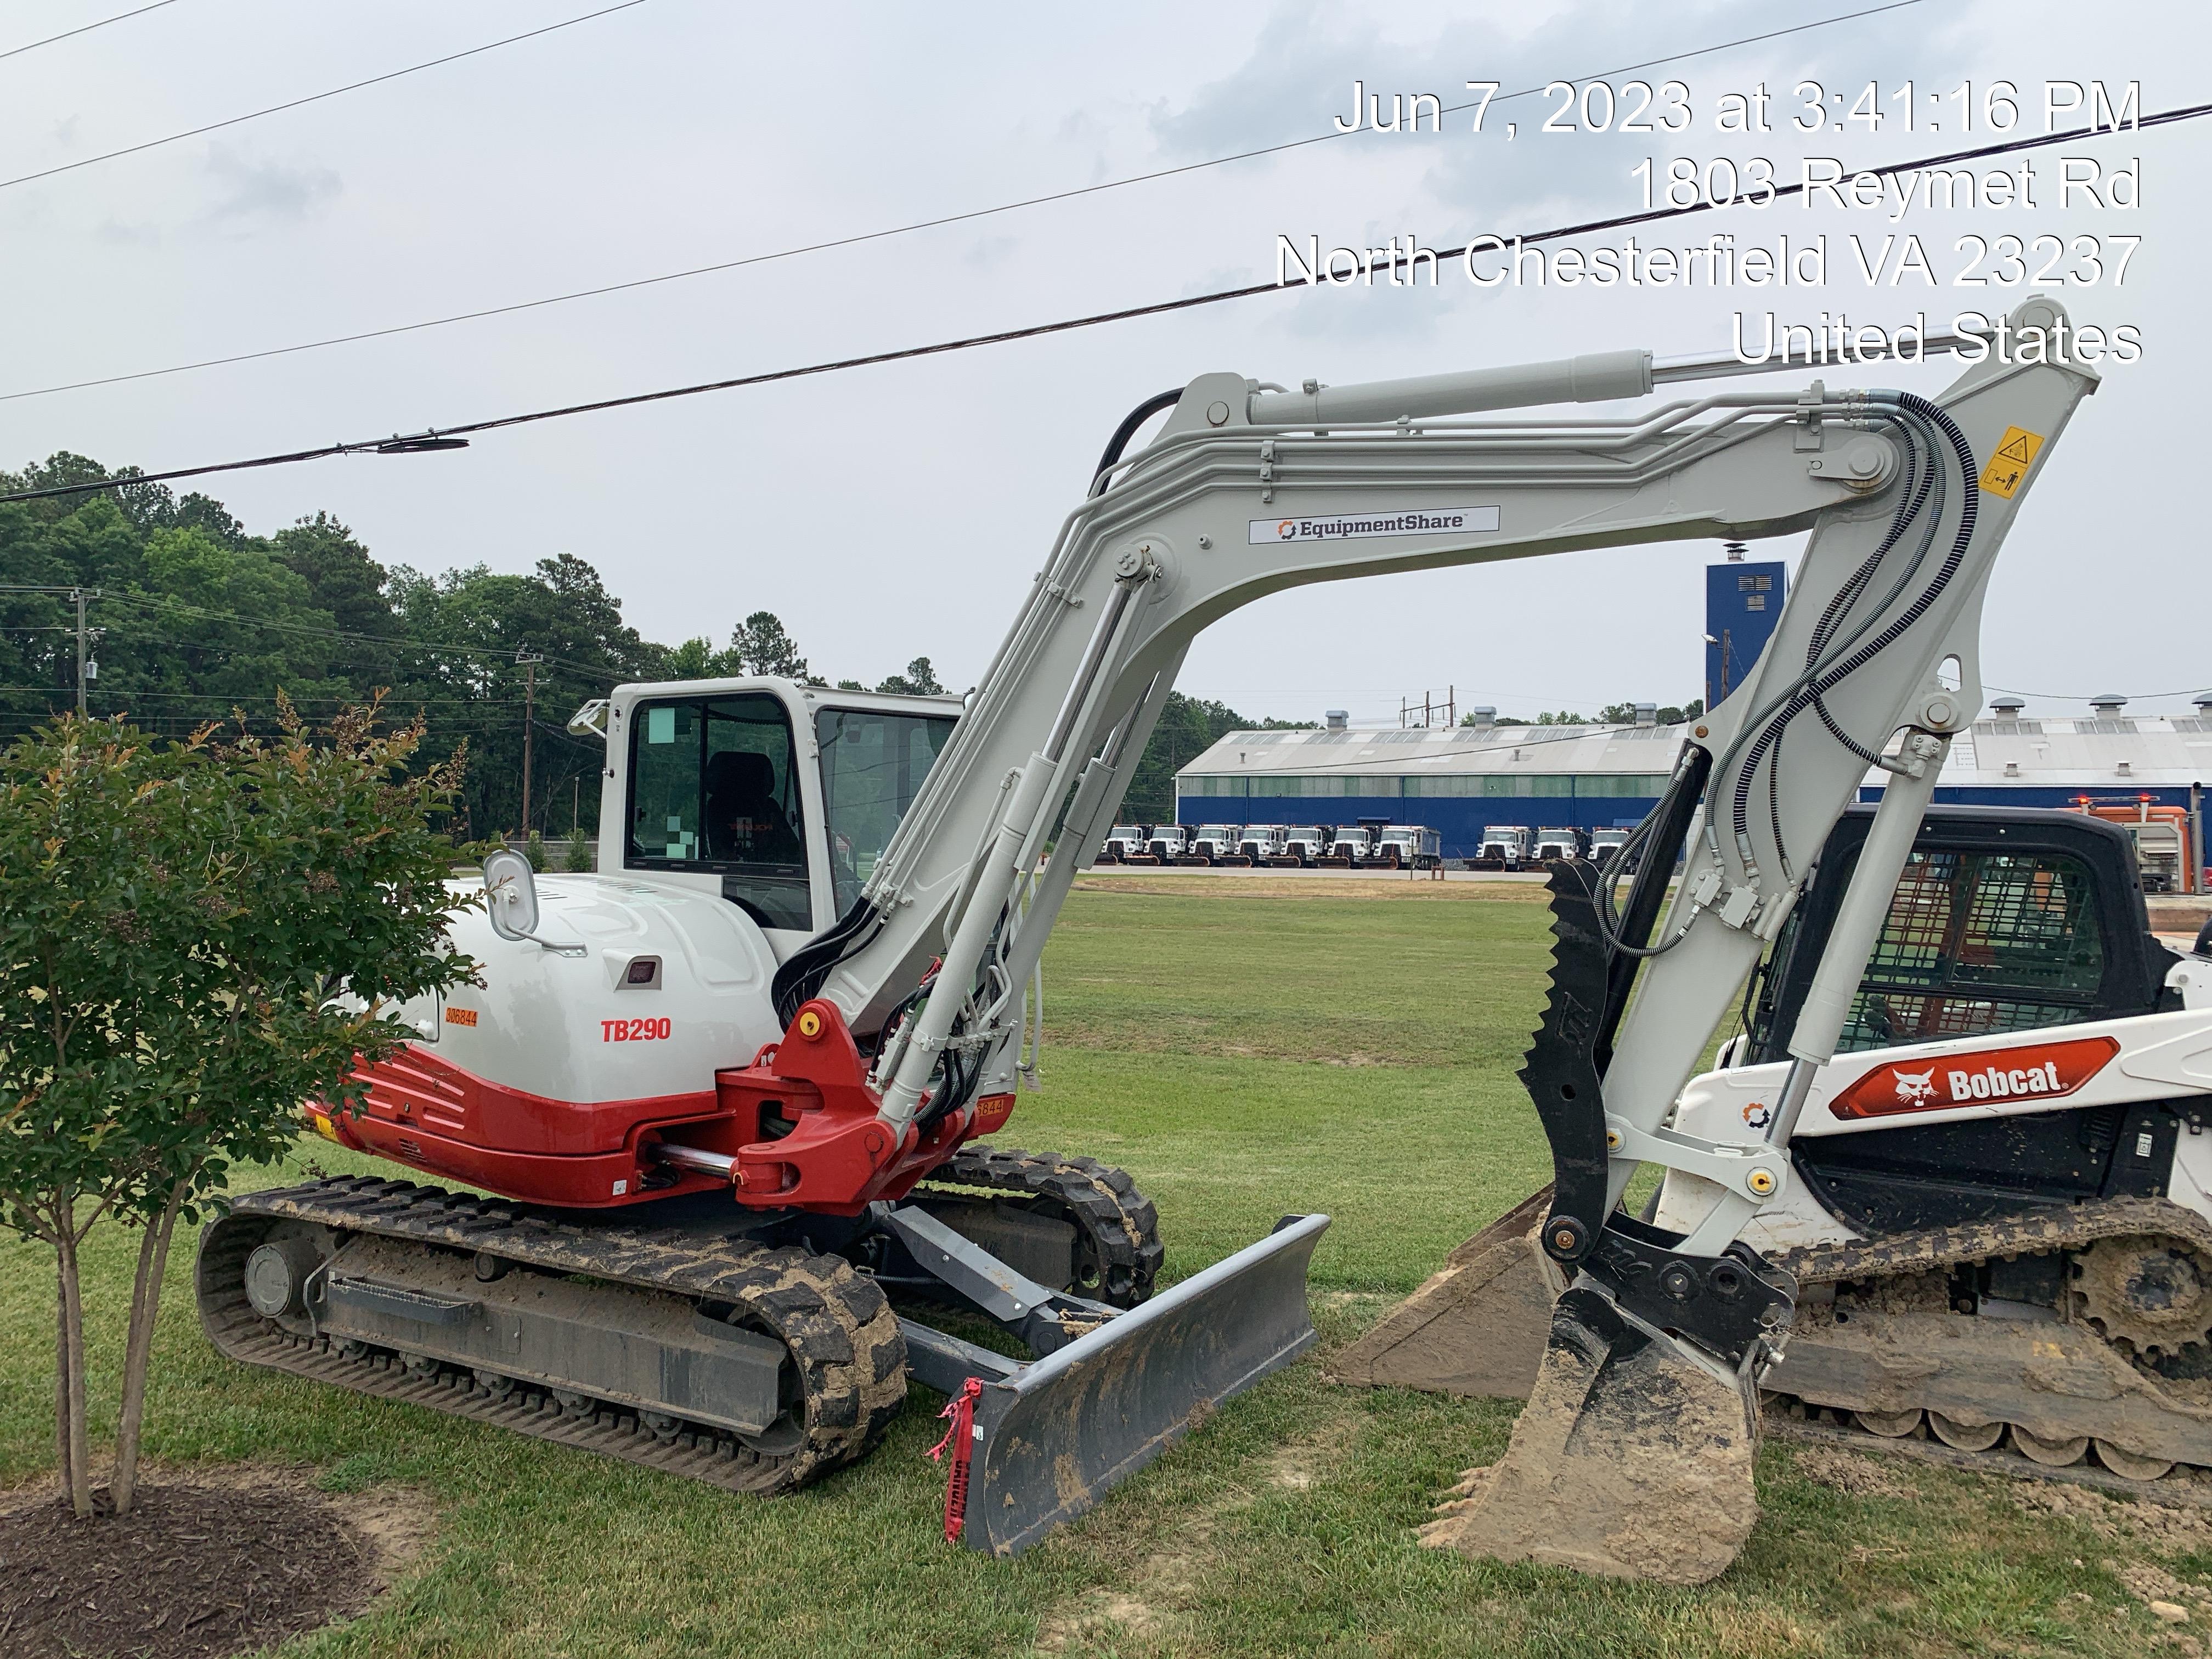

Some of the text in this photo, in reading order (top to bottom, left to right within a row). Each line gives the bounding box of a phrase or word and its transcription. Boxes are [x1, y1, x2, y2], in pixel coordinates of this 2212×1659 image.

[1300, 514, 1464, 538] EquipmentShare
[601, 1017, 671, 1042] TB290
[1948, 1062, 2061, 1101] Bobcat
